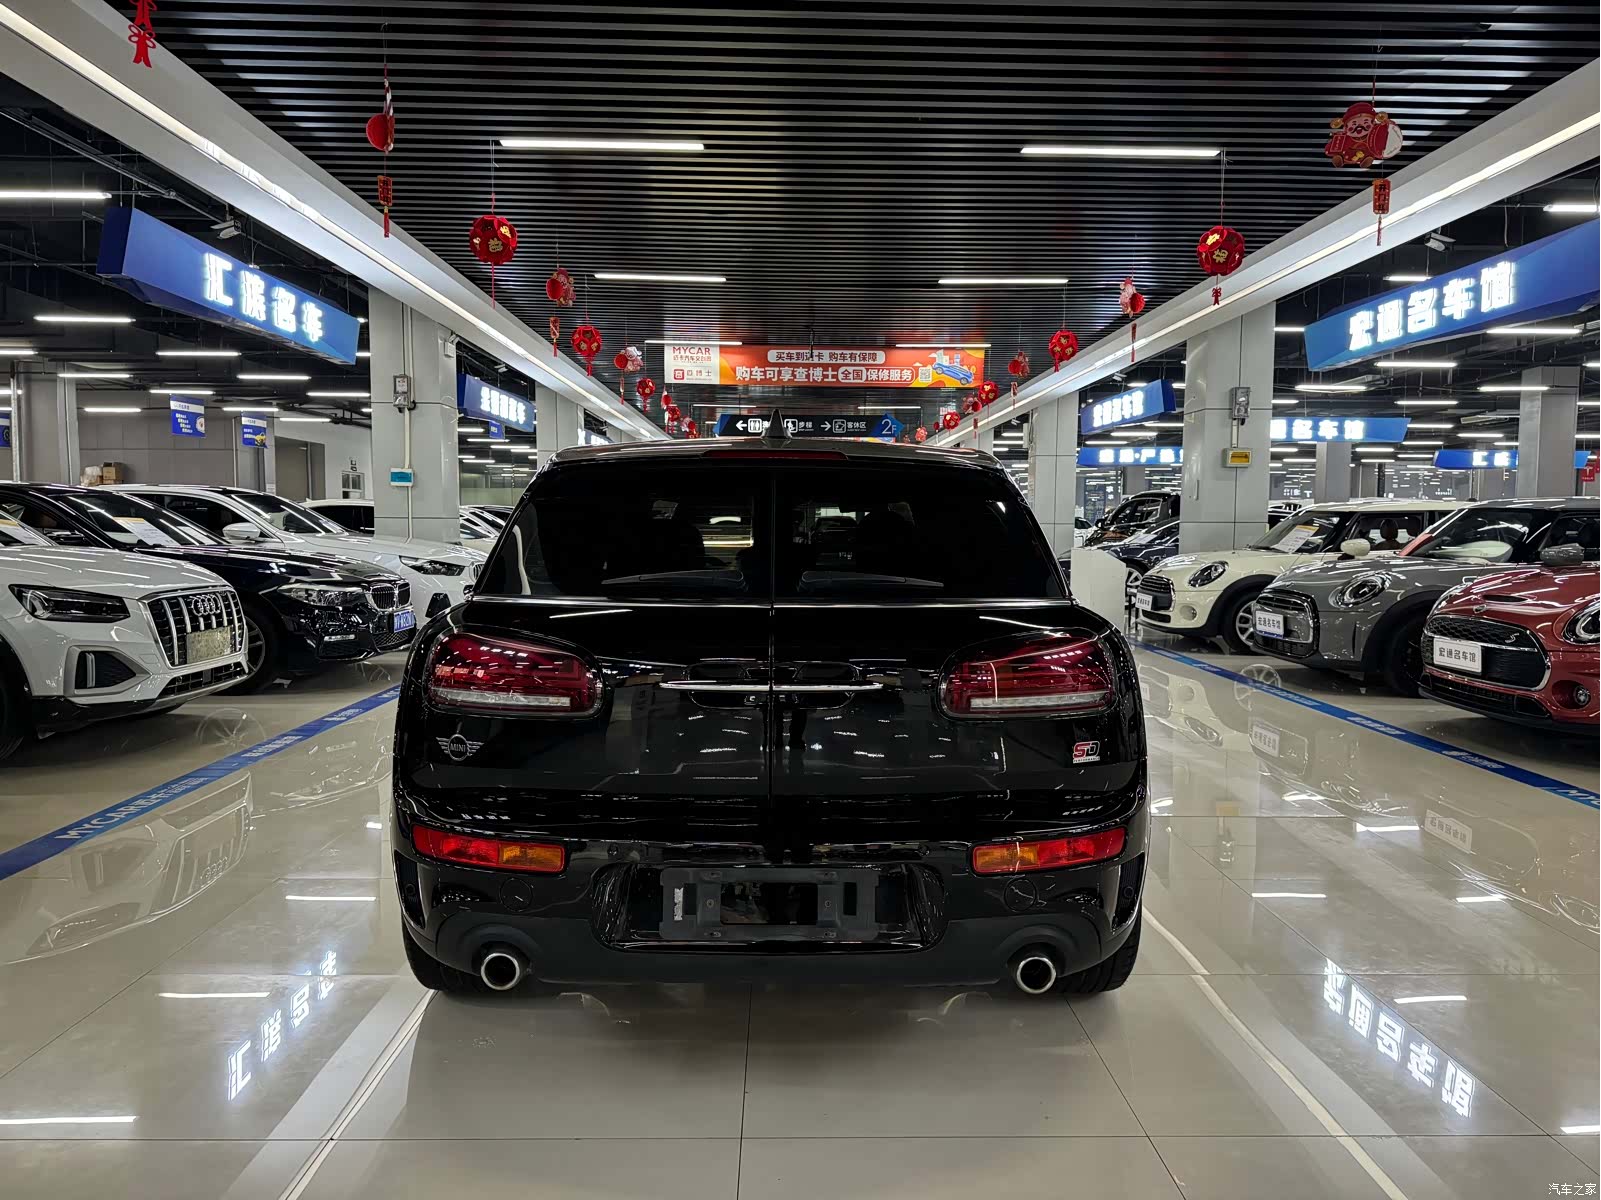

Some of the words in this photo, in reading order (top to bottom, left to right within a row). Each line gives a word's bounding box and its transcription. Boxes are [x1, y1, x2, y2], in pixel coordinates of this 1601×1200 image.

[1349, 260, 1518, 351] 宏通名车馆
[673, 346, 711, 355] MYCAR
[829, 351, 877, 362] 购车有保障
[881, 419, 897, 434] 2F
[1438, 646, 1477, 663] 宏通名车馆
